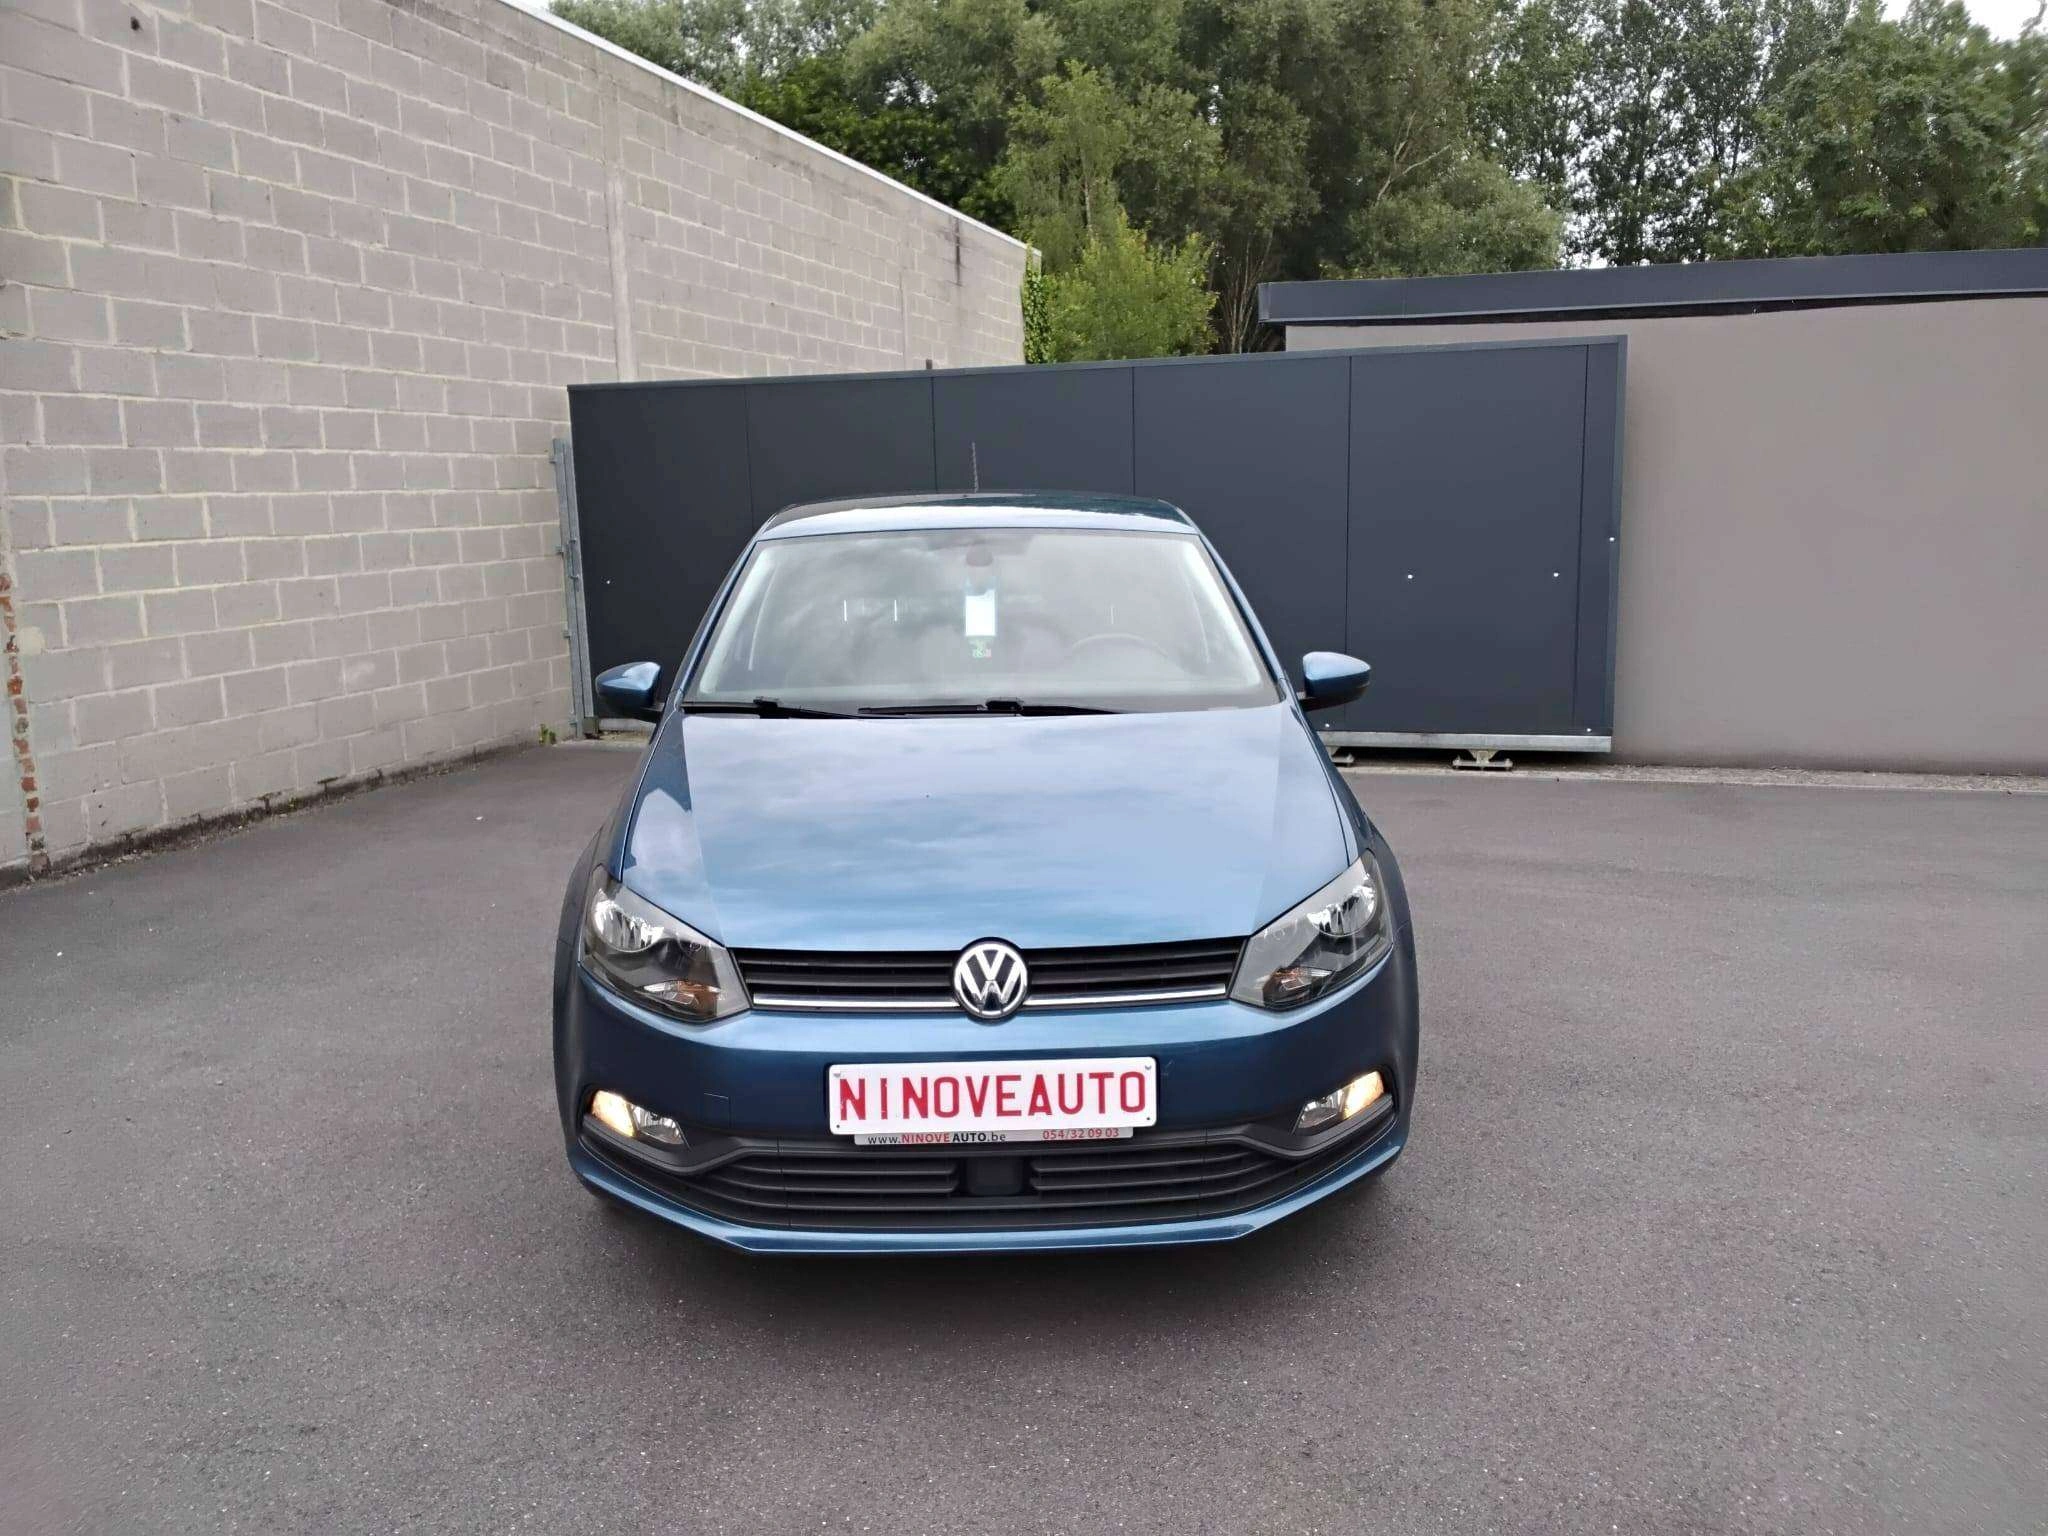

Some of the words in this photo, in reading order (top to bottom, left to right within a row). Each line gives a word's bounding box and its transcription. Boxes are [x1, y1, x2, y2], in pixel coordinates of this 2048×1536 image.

[955, 943, 1027, 1017] VW
[839, 1071, 1146, 1121] NINOVEAUTO
[867, 1131, 1007, 1144] www.NINOVEAUTO.be
[1042, 1129, 1085, 1140] 054/32
